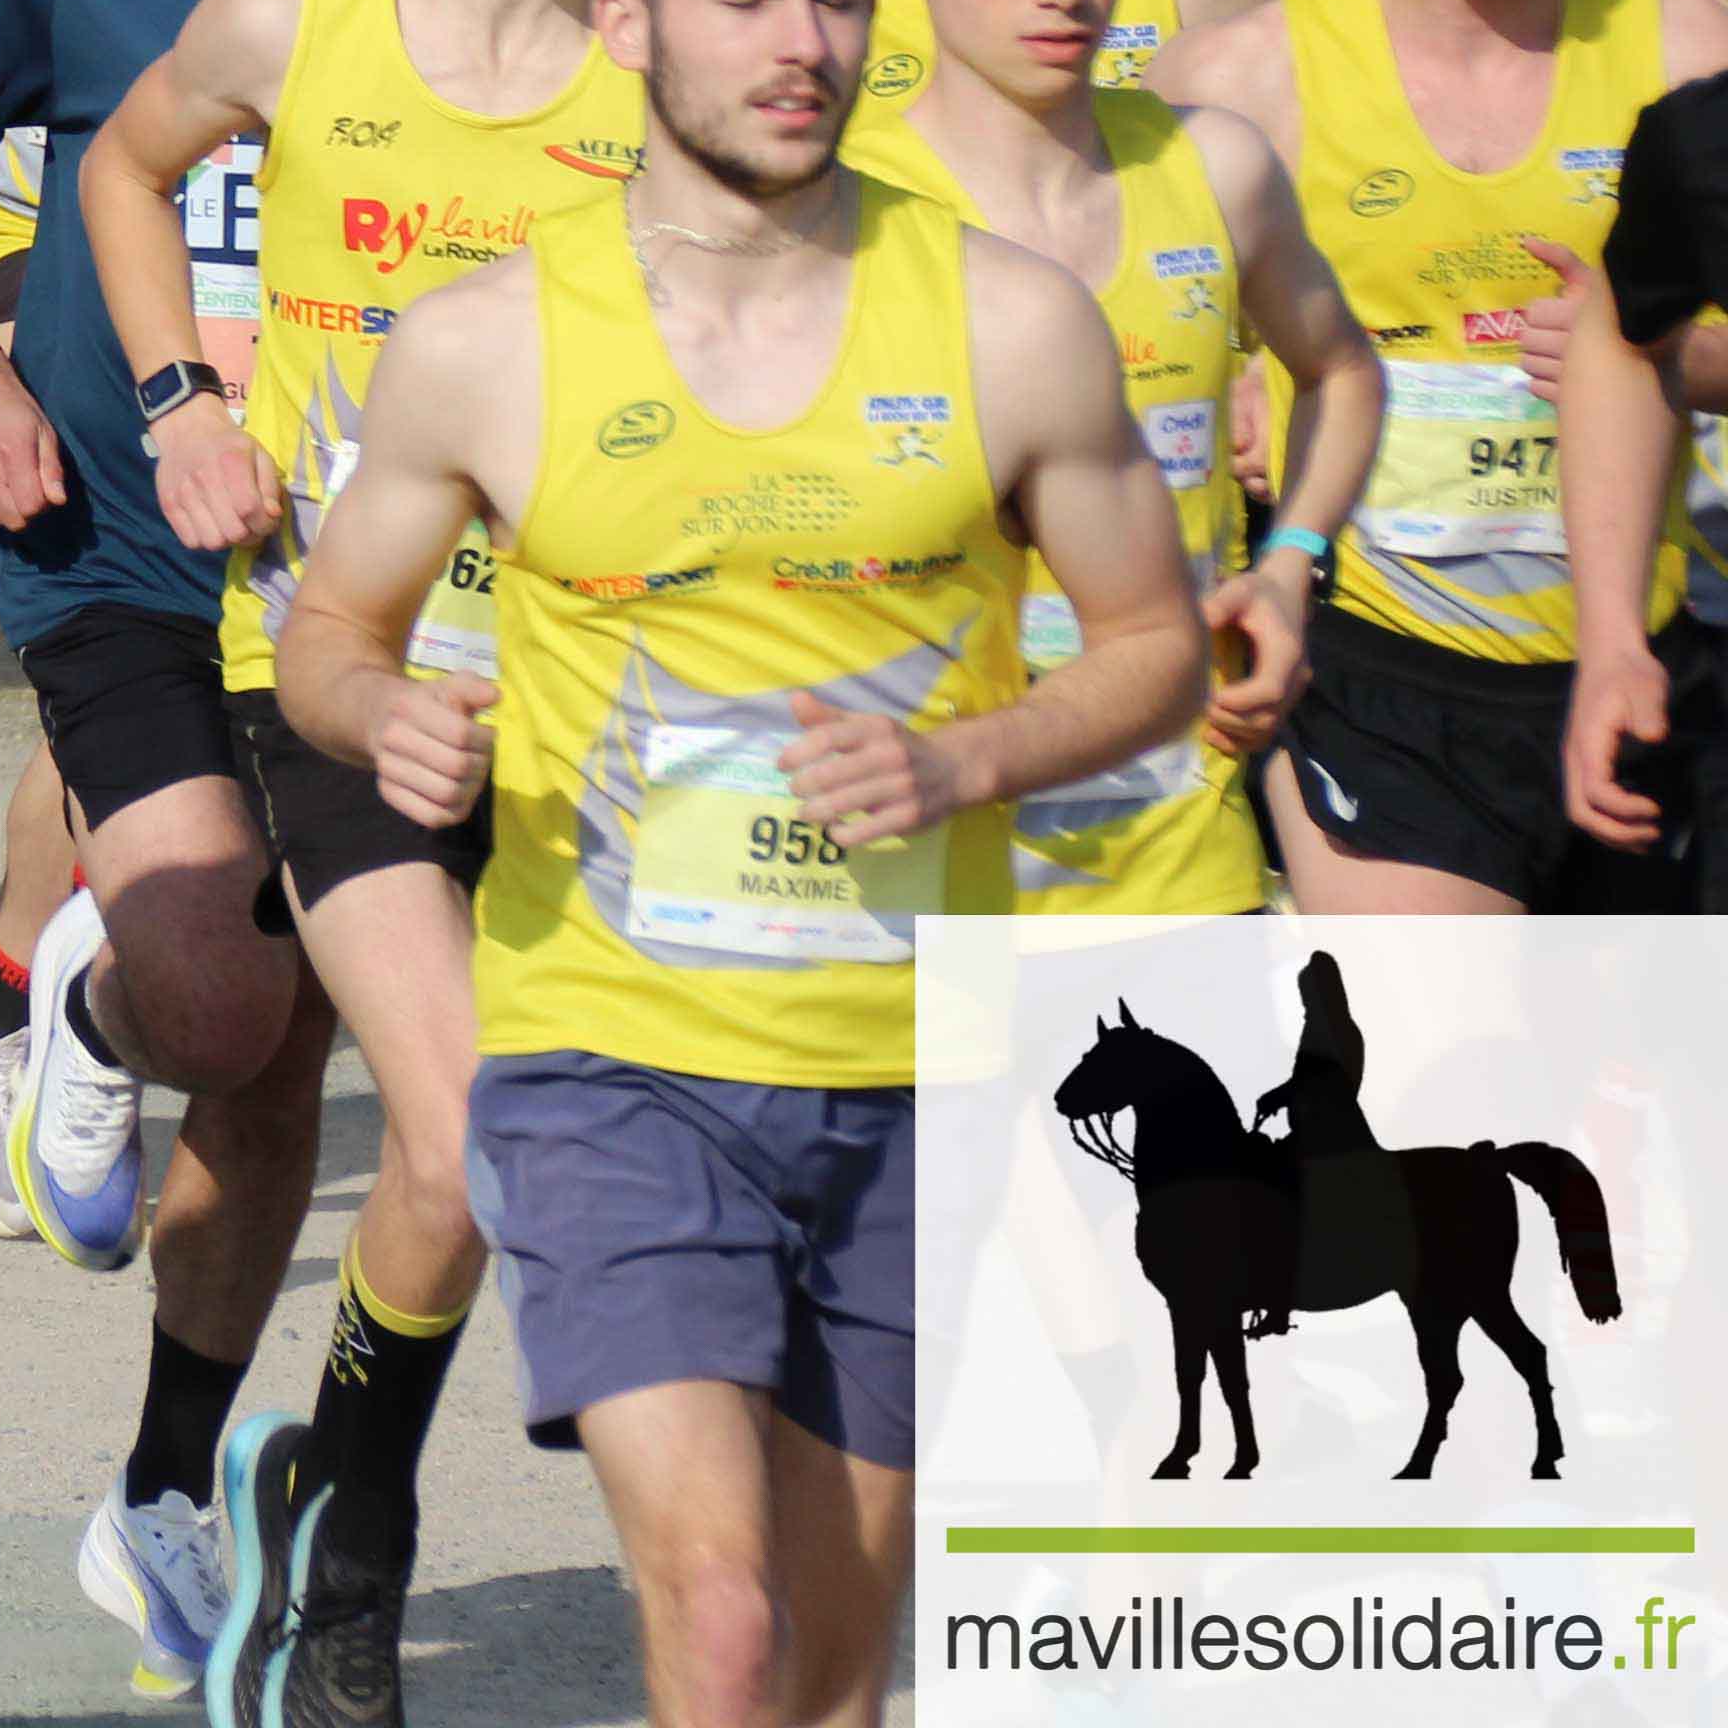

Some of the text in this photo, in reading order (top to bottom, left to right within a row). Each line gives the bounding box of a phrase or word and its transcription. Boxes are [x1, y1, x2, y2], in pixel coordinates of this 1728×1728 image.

[190, 198, 217, 217] LE
[344, 198, 428, 274] Ry
[432, 196, 473, 239] la
[482, 205, 532, 245] vill
[1470, 436, 1560, 476] 947
[1467, 487, 1557, 507] JUSTIN
[448, 549, 495, 595] 62
[773, 557, 855, 580] Crédit
[750, 815, 845, 866] 958
[739, 871, 850, 902] MAXIME
